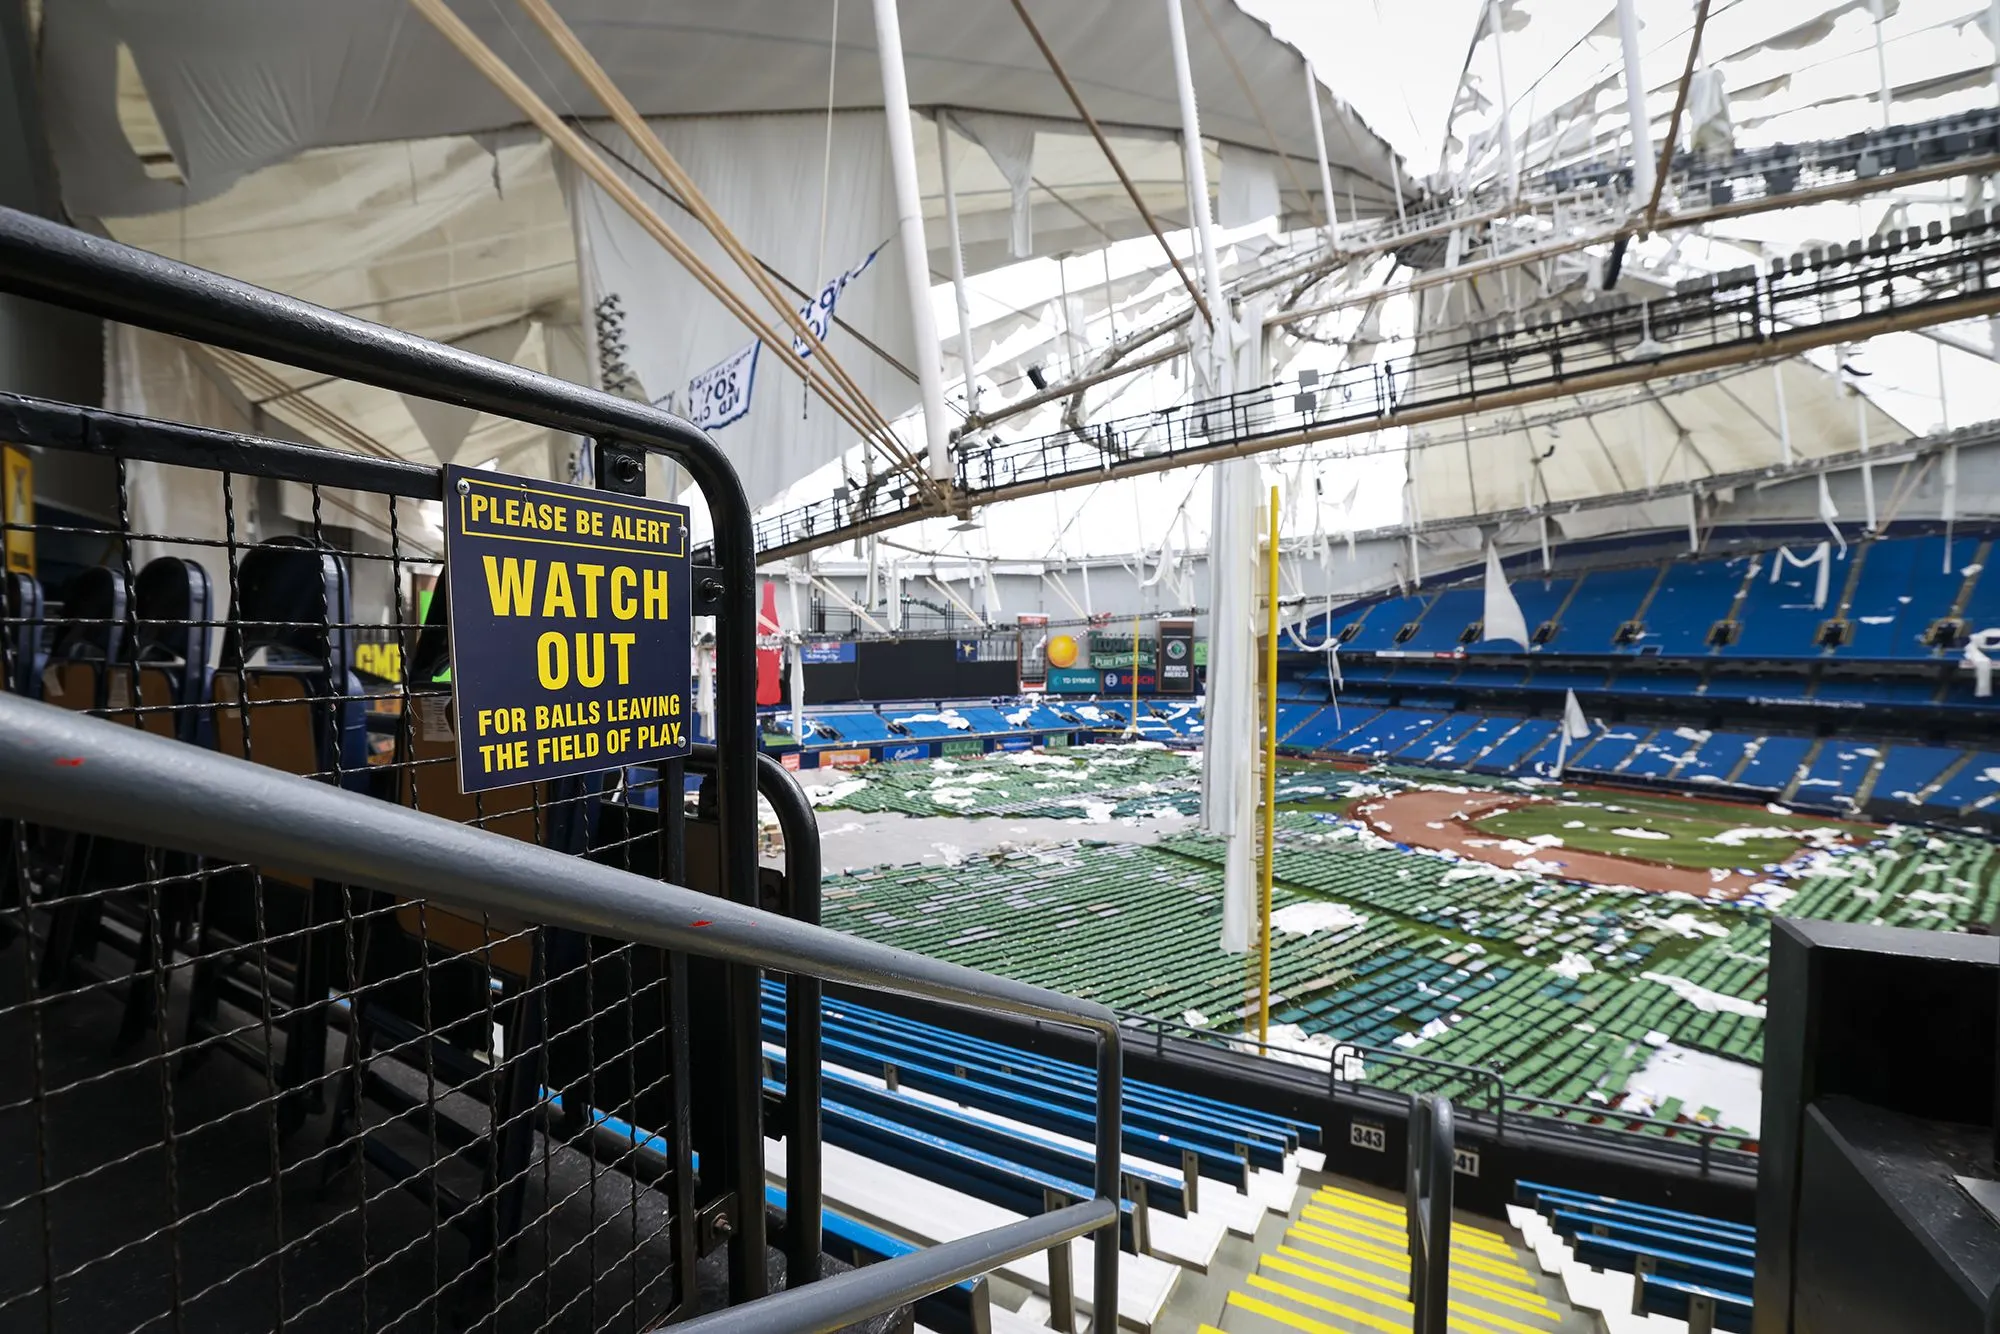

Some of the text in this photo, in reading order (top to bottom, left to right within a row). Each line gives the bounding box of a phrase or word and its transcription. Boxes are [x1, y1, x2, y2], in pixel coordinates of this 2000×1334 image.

[470, 494, 671, 545] PLEASE BE ALERT
[482, 555, 669, 621] WATCH
[536, 631, 636, 690] OUT
[1115, 654, 1149, 665] PREMUM
[478, 707, 527, 737] FOR
[536, 700, 601, 731] BALLS
[607, 694, 681, 723] LEAVING
[479, 722, 682, 773] THE FIELD OF PLAY
[1353, 1126, 1383, 1148] 343
